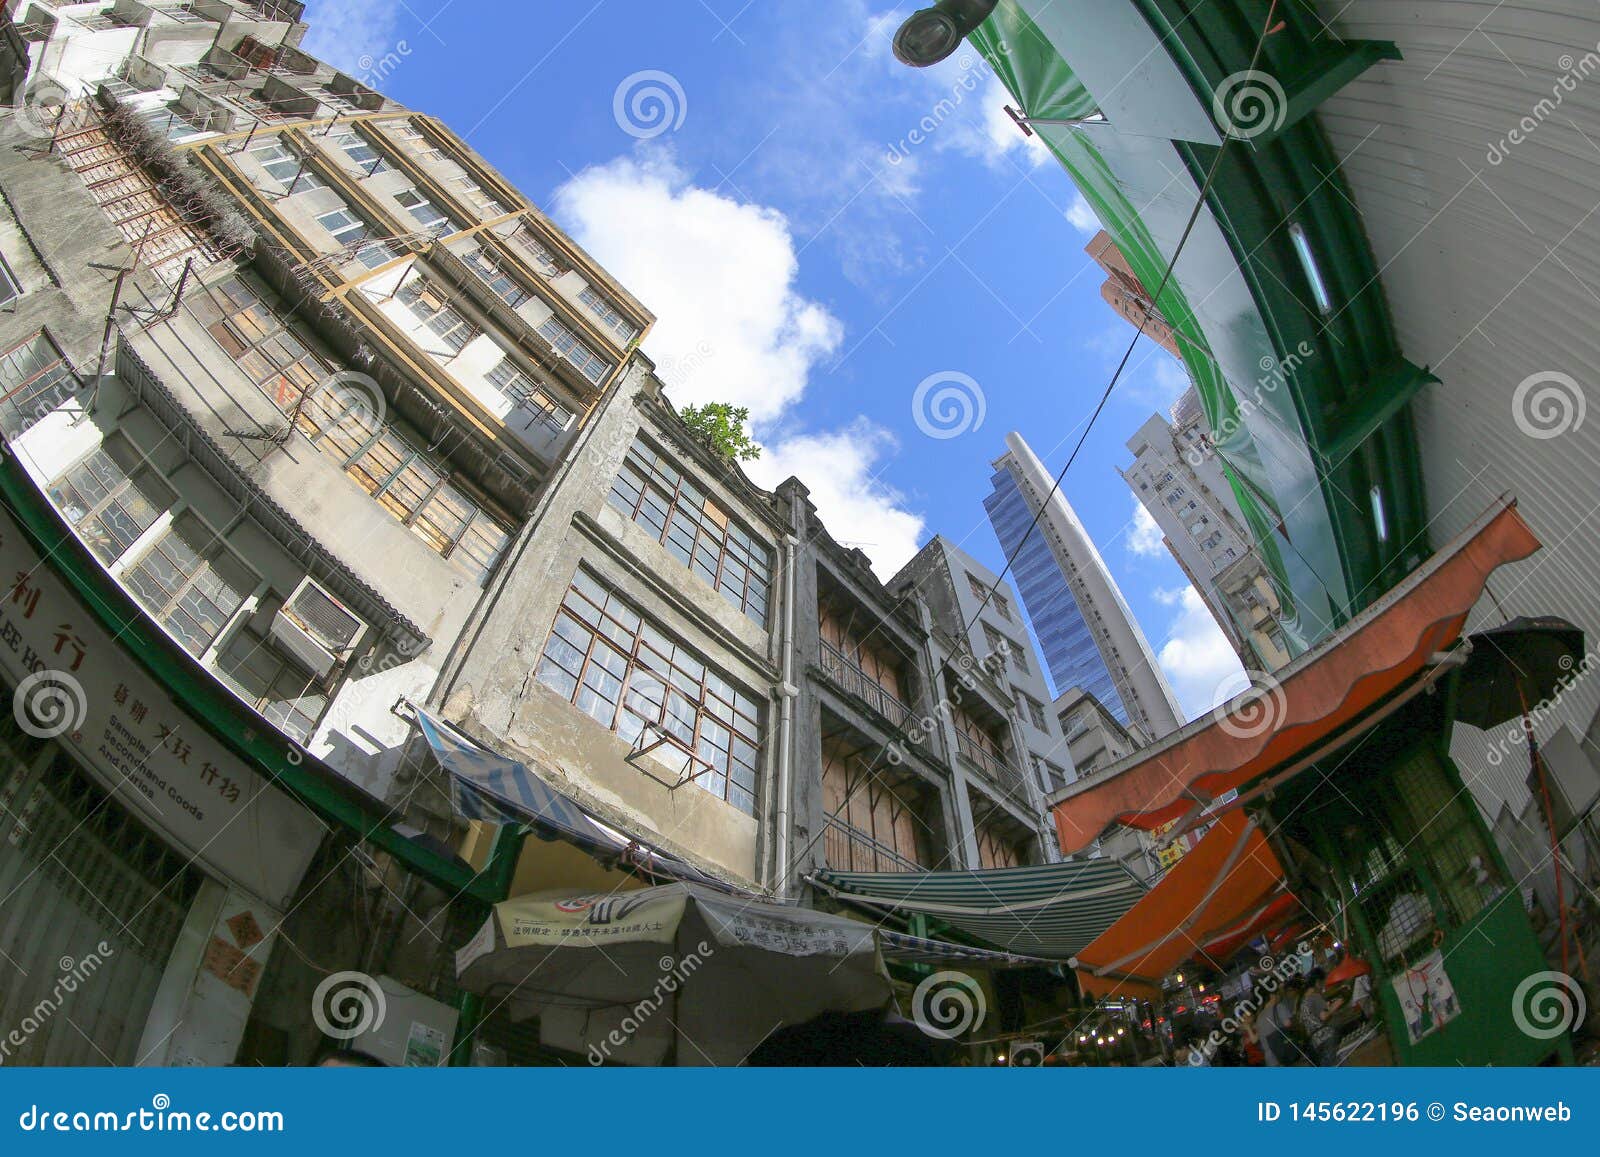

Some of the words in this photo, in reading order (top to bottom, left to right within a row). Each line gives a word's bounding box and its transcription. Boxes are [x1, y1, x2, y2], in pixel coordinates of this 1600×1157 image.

[98, 744, 120, 767] And
[120, 764, 154, 799] Curios
[103, 729, 166, 791] Secondhand
[168, 786, 204, 821] Goods
